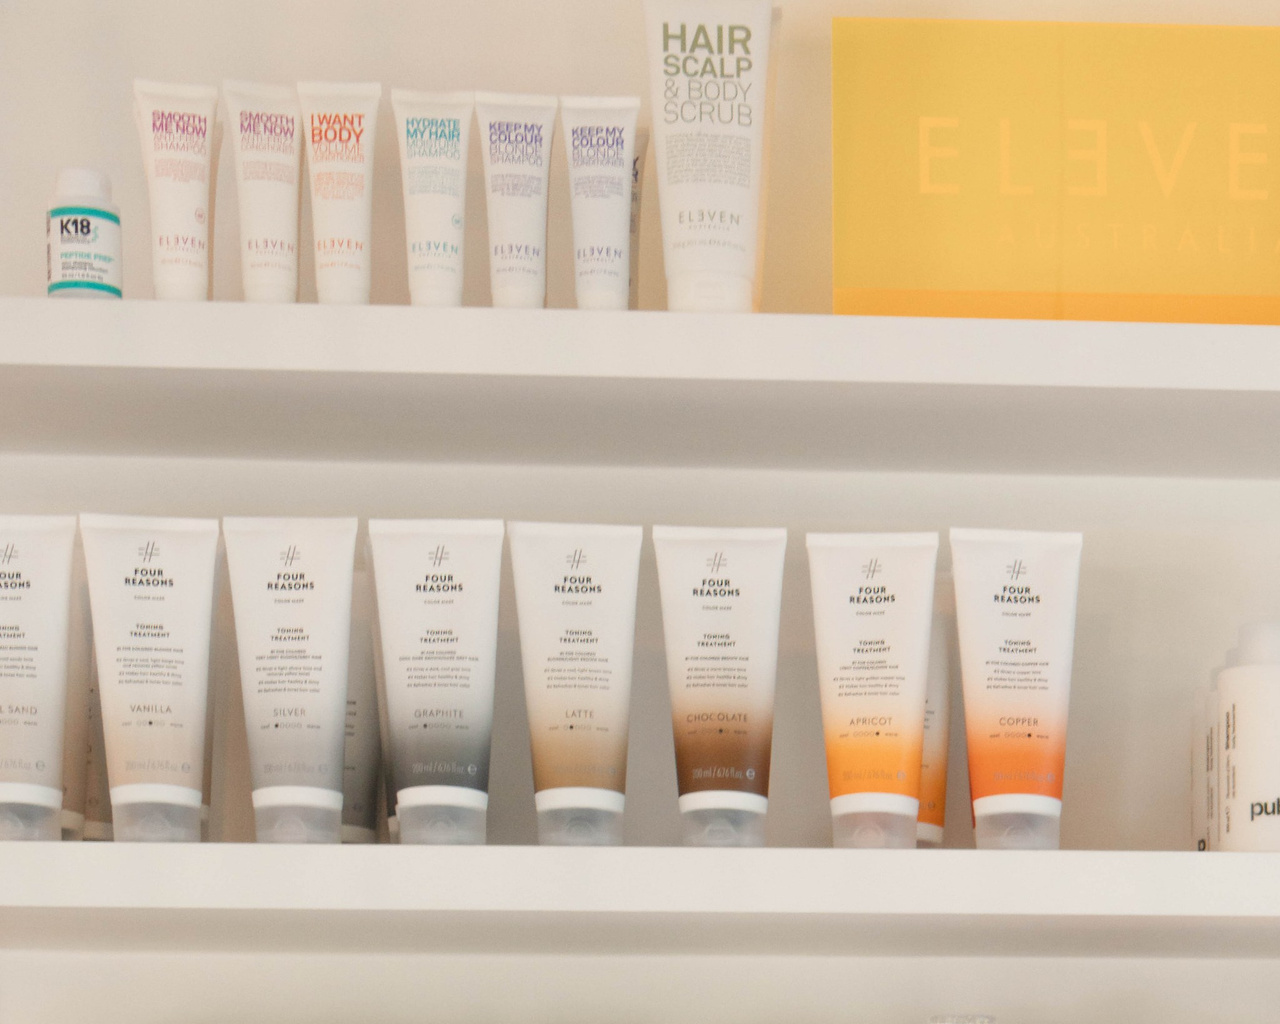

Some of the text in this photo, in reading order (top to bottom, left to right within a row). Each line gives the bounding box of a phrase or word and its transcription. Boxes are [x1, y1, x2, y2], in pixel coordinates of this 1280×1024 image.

[662, 22, 752, 55] HAIR
[663, 55, 752, 79] SCALP
[664, 79, 752, 101] & BODY
[663, 101, 752, 126] SCRUB
[318, 113, 364, 128] WANT
[406, 117, 460, 130] HYDRATE
[489, 122, 543, 135] KEEP MY
[311, 127, 364, 144] BODY
[406, 129, 460, 142] MY HAIR
[489, 132, 543, 145] COLOUR
[60, 218, 91, 236] K18
[134, 568, 164, 578] FOUR
[425, 575, 454, 584] FOUR
[124, 578, 174, 588] REASONS
[415, 583, 464, 593] REASONS
[702, 579, 731, 588] FOUR
[692, 588, 741, 598] REASONS
[130, 704, 173, 715] VANILLA
[273, 708, 307, 718] SILVER
[849, 717, 893, 727] APRICOT
[999, 717, 1039, 727] COPPER
